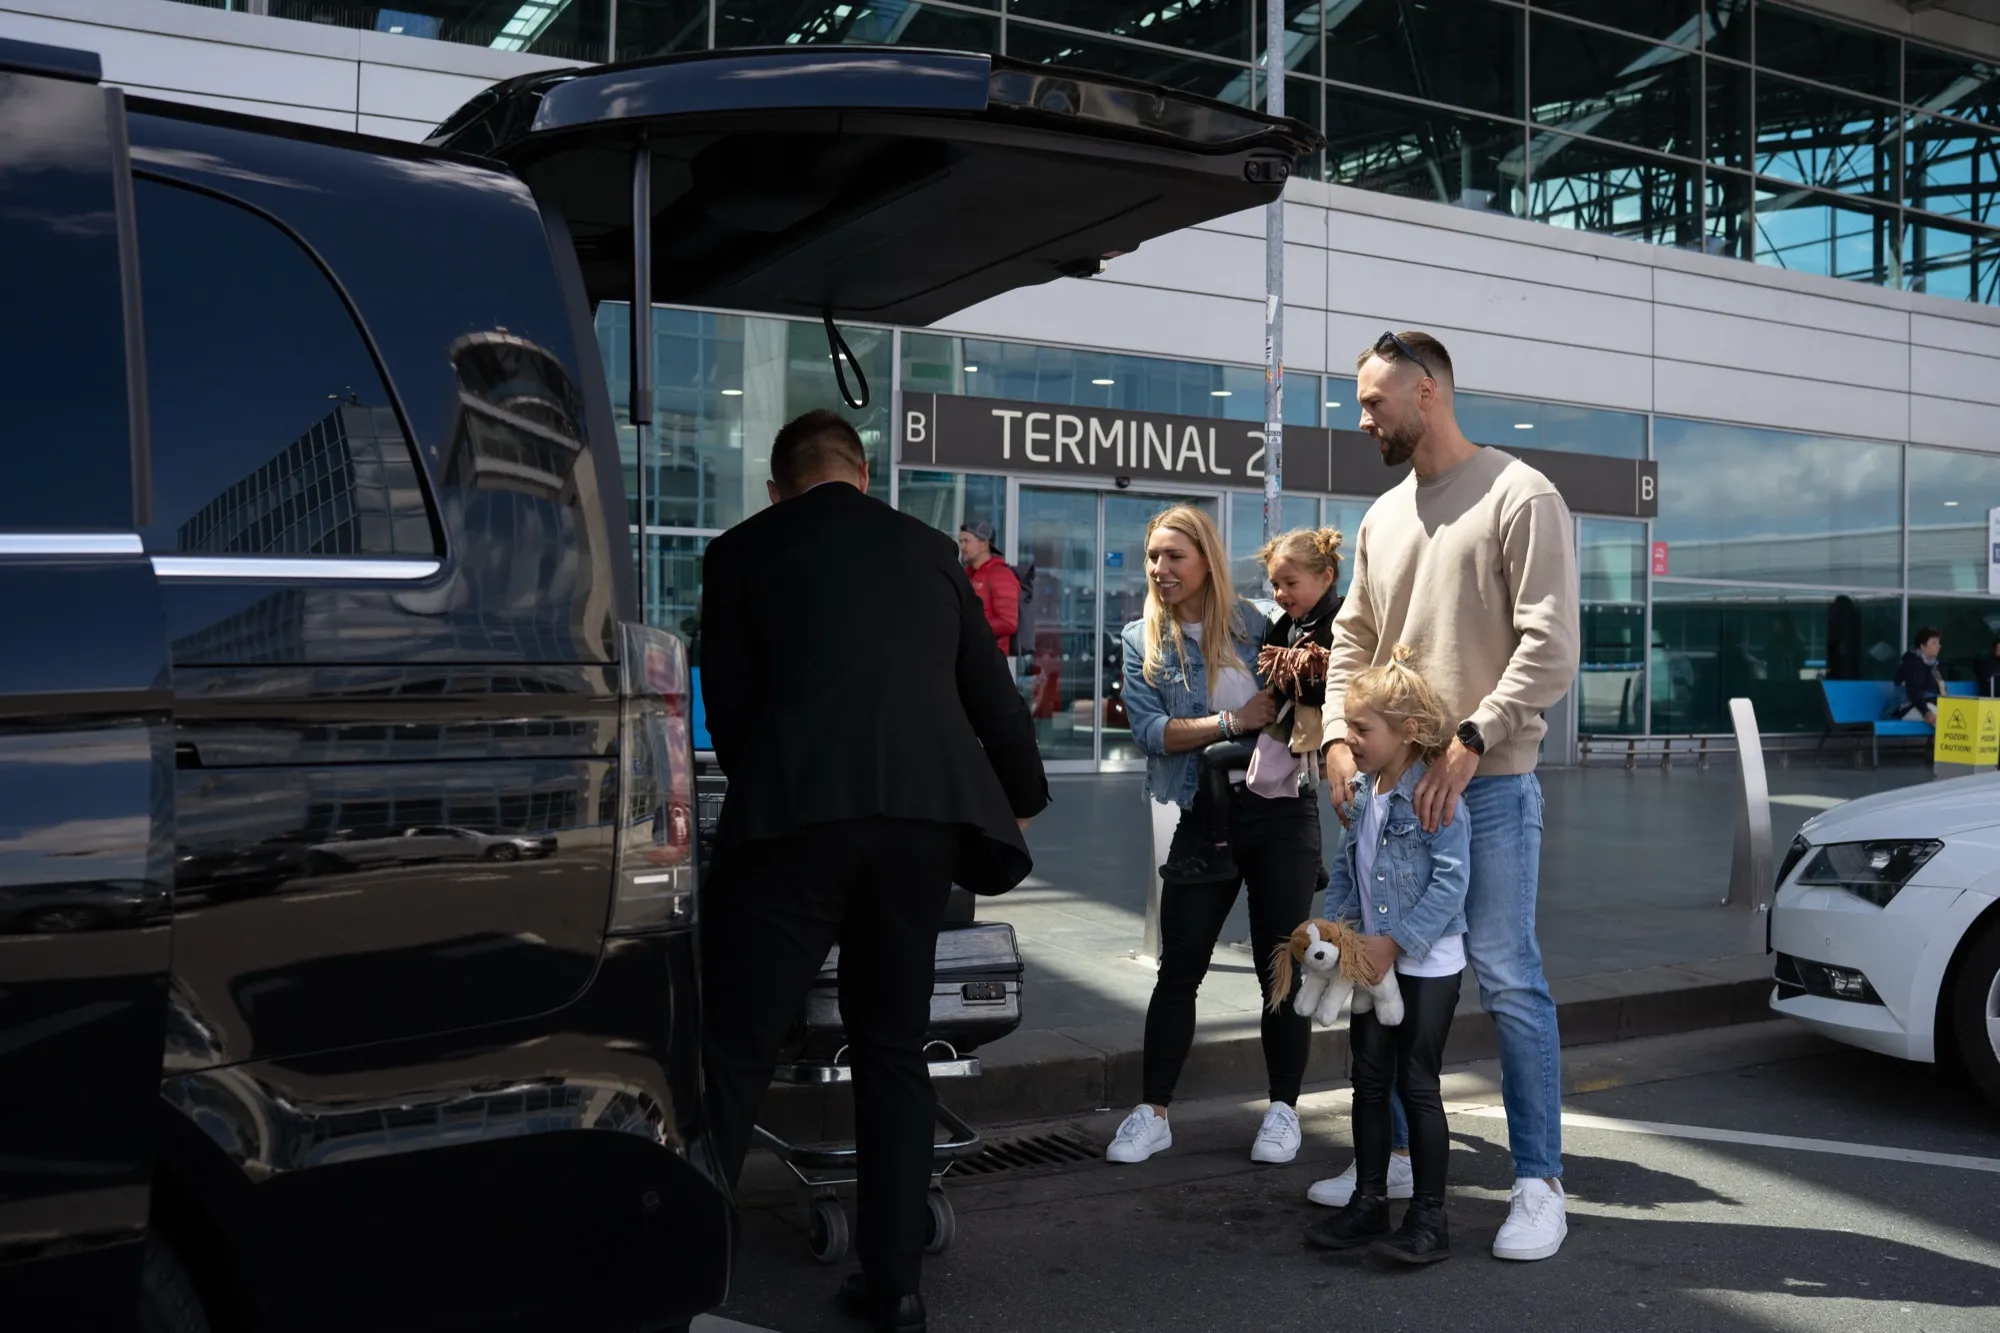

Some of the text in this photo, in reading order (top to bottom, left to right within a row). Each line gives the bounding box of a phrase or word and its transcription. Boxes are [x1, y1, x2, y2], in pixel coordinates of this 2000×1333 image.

[907, 411, 926, 443] B
[991, 409, 1266, 477] TERMINAL 2
[1642, 475, 1654, 501] B
